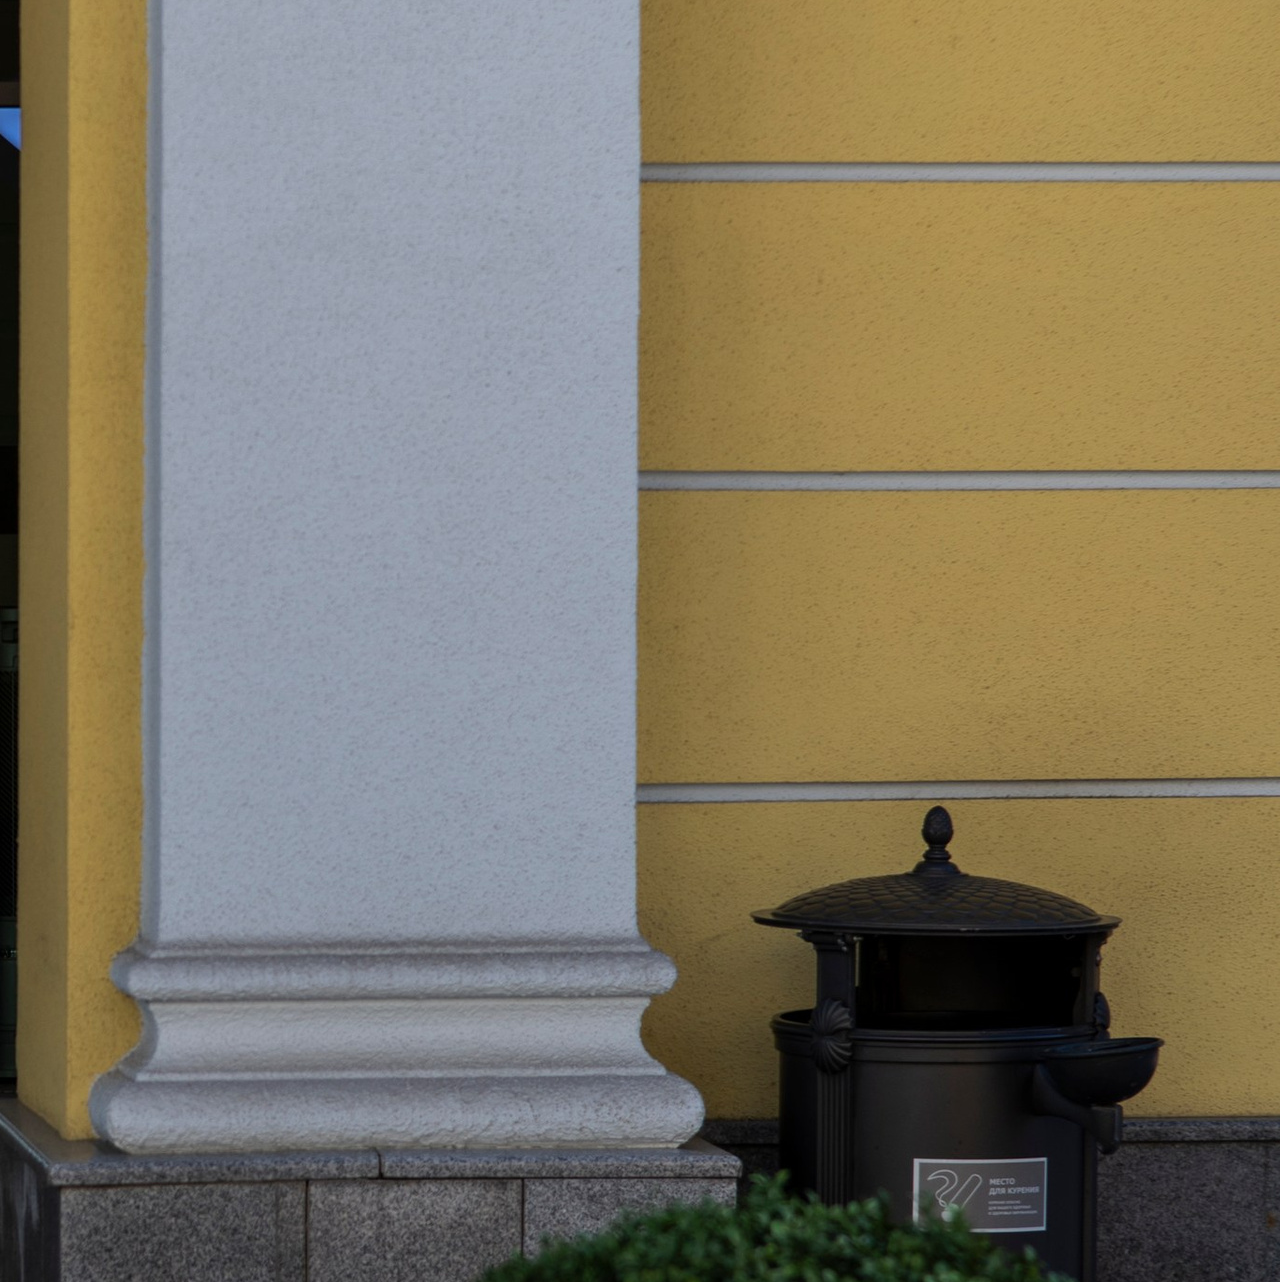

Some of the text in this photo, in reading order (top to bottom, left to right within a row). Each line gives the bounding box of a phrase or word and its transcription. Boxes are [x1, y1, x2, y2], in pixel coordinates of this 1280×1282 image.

[989, 1178, 1016, 1186] МЕСТО
[989, 1186, 1040, 1196] ДЛЯ КУРЕНИЯ
